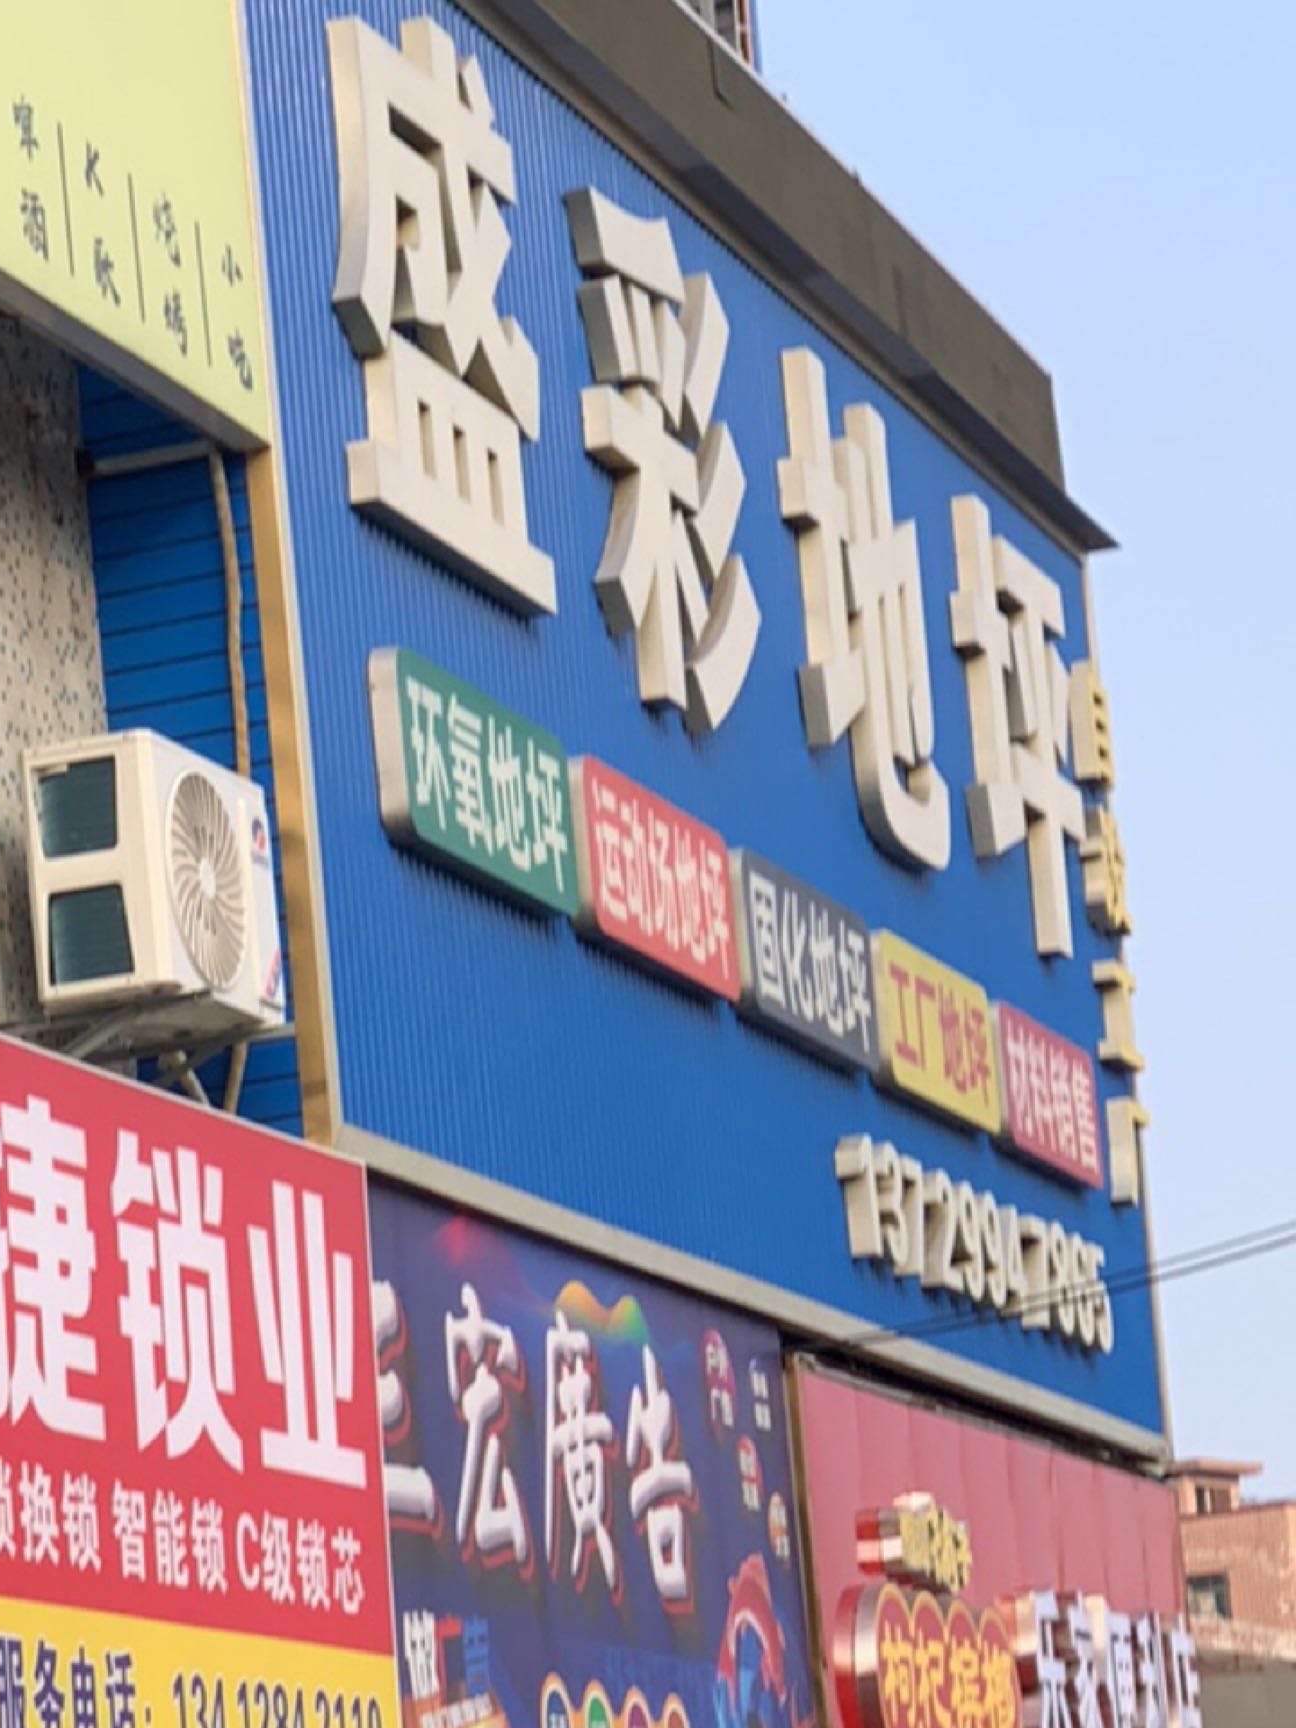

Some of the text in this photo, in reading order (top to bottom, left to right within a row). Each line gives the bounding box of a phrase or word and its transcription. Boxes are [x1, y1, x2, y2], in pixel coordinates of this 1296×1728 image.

[327, 15, 1085, 957] 盛彩地坪
[407, 676, 568, 894] 环氧地坪
[592, 777, 732, 982] 运动场地坪
[749, 867, 872, 1053] 固化地坪
[888, 964, 991, 1109] 工厂地坪
[1006, 1025, 1099, 1174] 材料销售
[114, 1482, 228, 1591] 智能锁
[236, 1516, 365, 1614] C级锁芯
